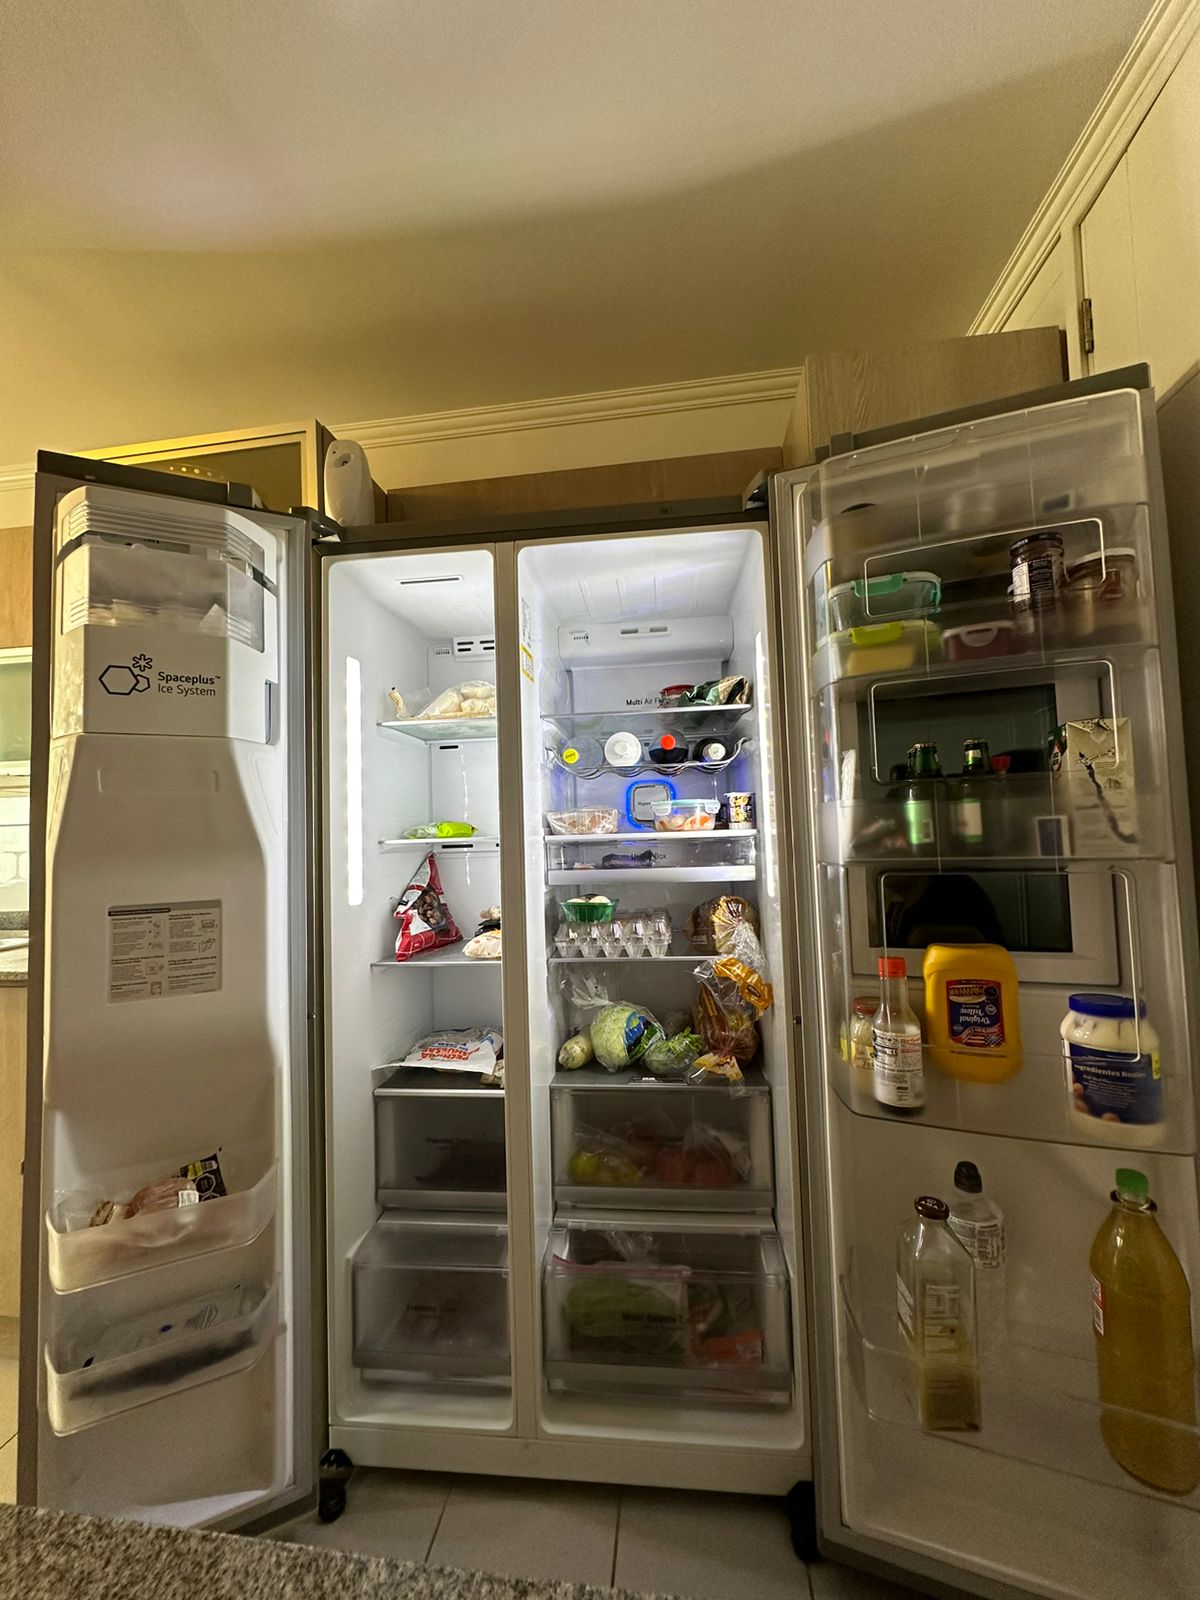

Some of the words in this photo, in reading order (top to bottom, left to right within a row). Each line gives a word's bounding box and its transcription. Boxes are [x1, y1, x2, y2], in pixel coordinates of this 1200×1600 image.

[158, 671, 215, 686] Spaceplus
[158, 683, 173, 694] Ice
[177, 684, 216, 697] System
[960, 1008, 984, 1017] Yellow
[959, 1015, 990, 1025] Original
